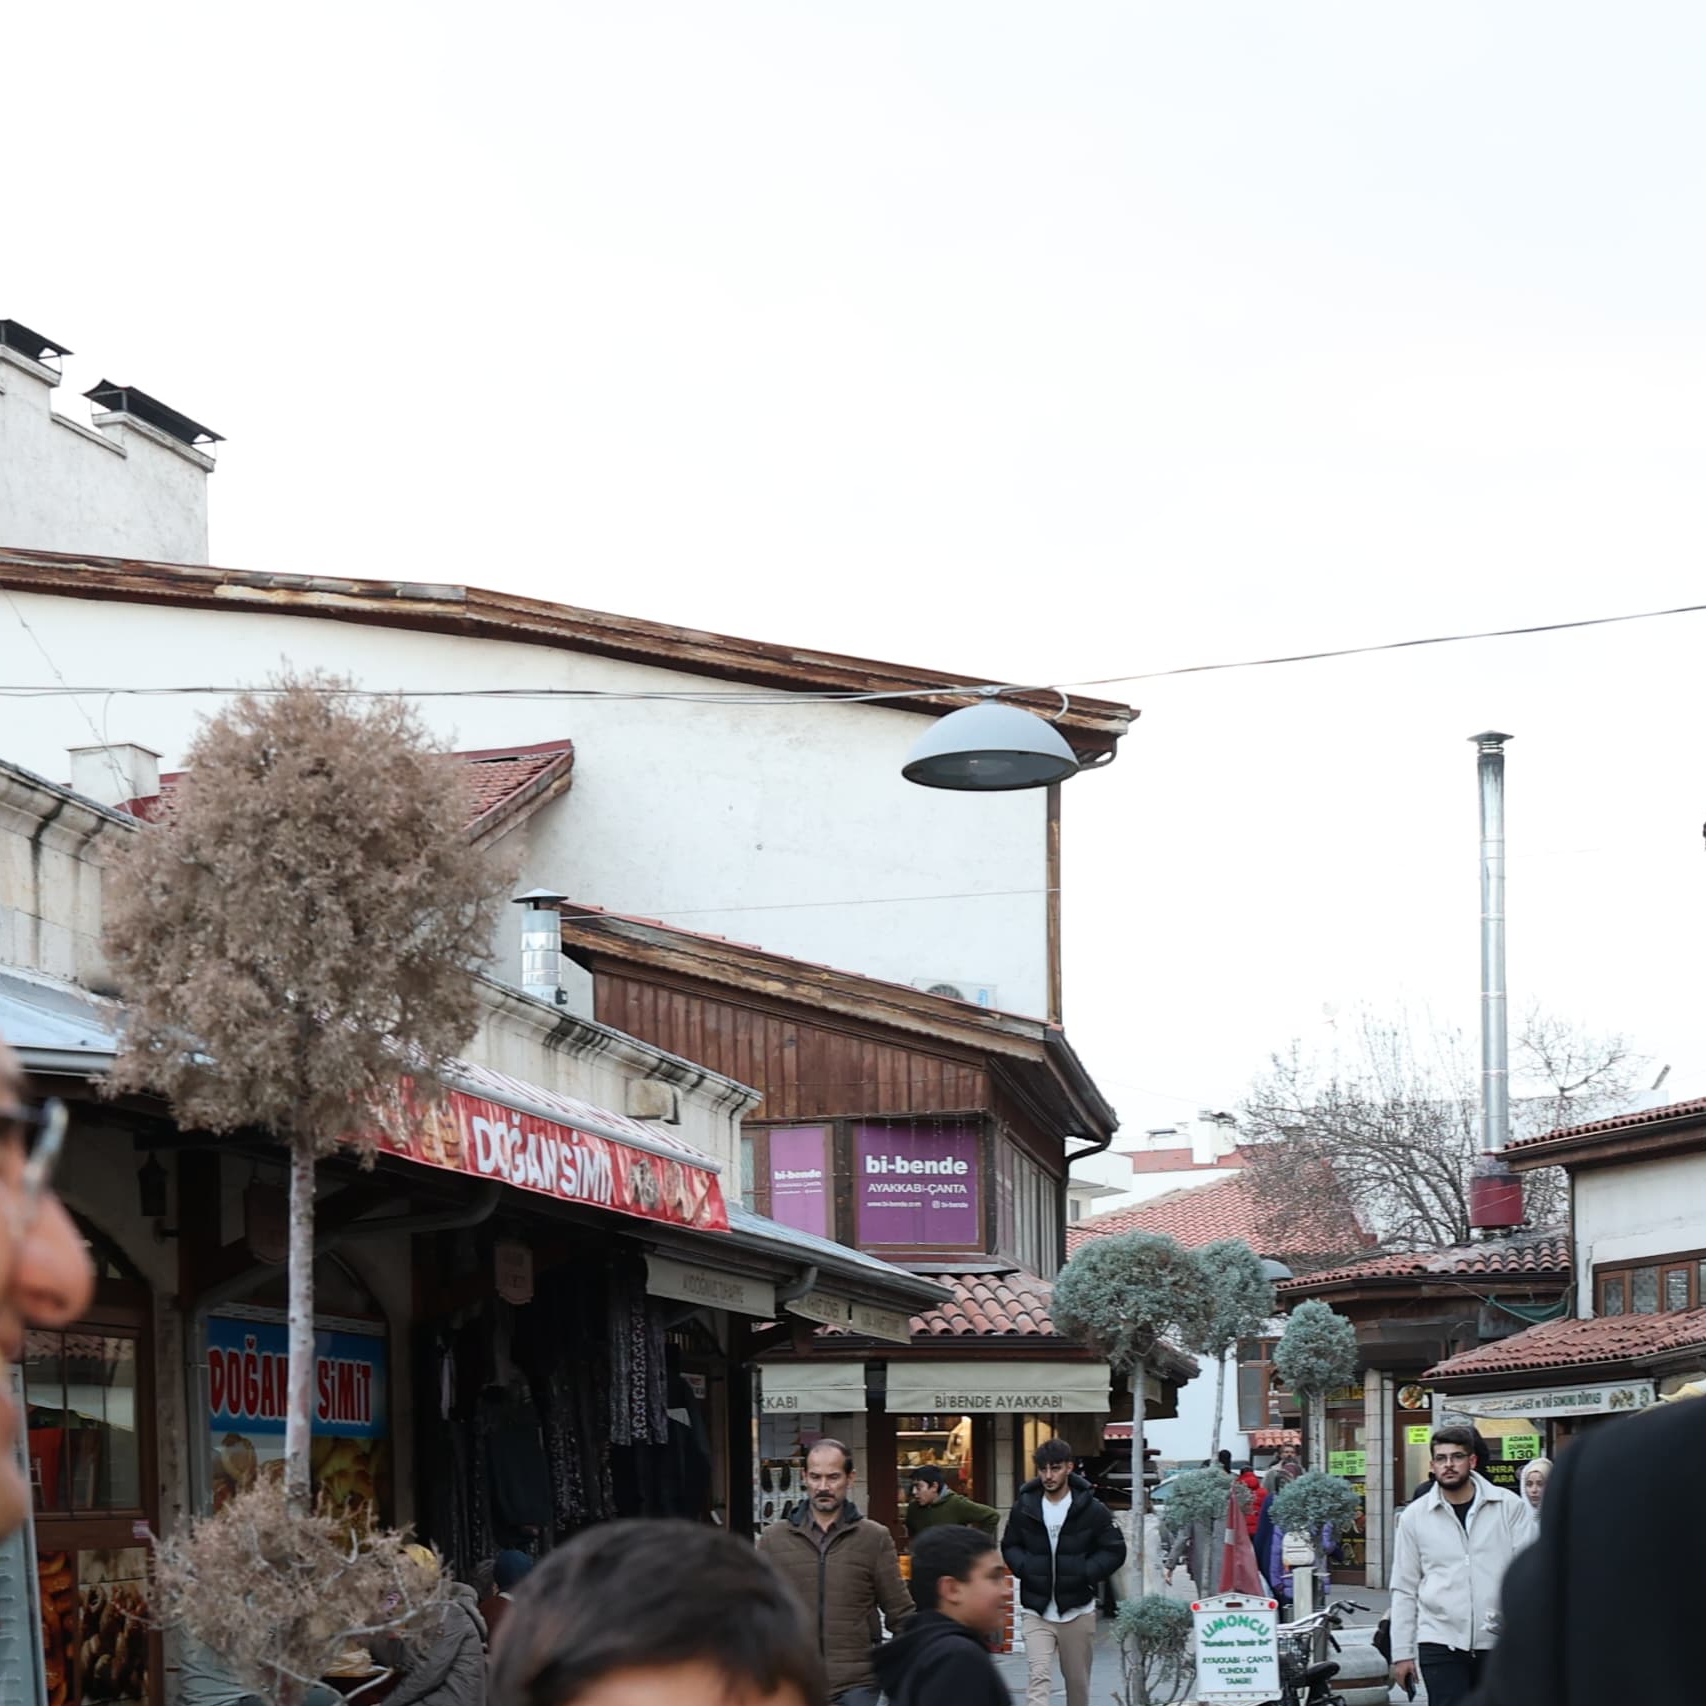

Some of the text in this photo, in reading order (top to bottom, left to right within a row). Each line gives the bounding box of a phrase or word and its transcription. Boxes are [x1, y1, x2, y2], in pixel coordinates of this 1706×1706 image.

[472, 1114, 559, 1191] DOĞAN
[865, 1155, 969, 1175] bi-bende
[995, 1395, 1064, 1410] AYAKKABI
[1218, 1666, 1259, 1674] KUNDURA
